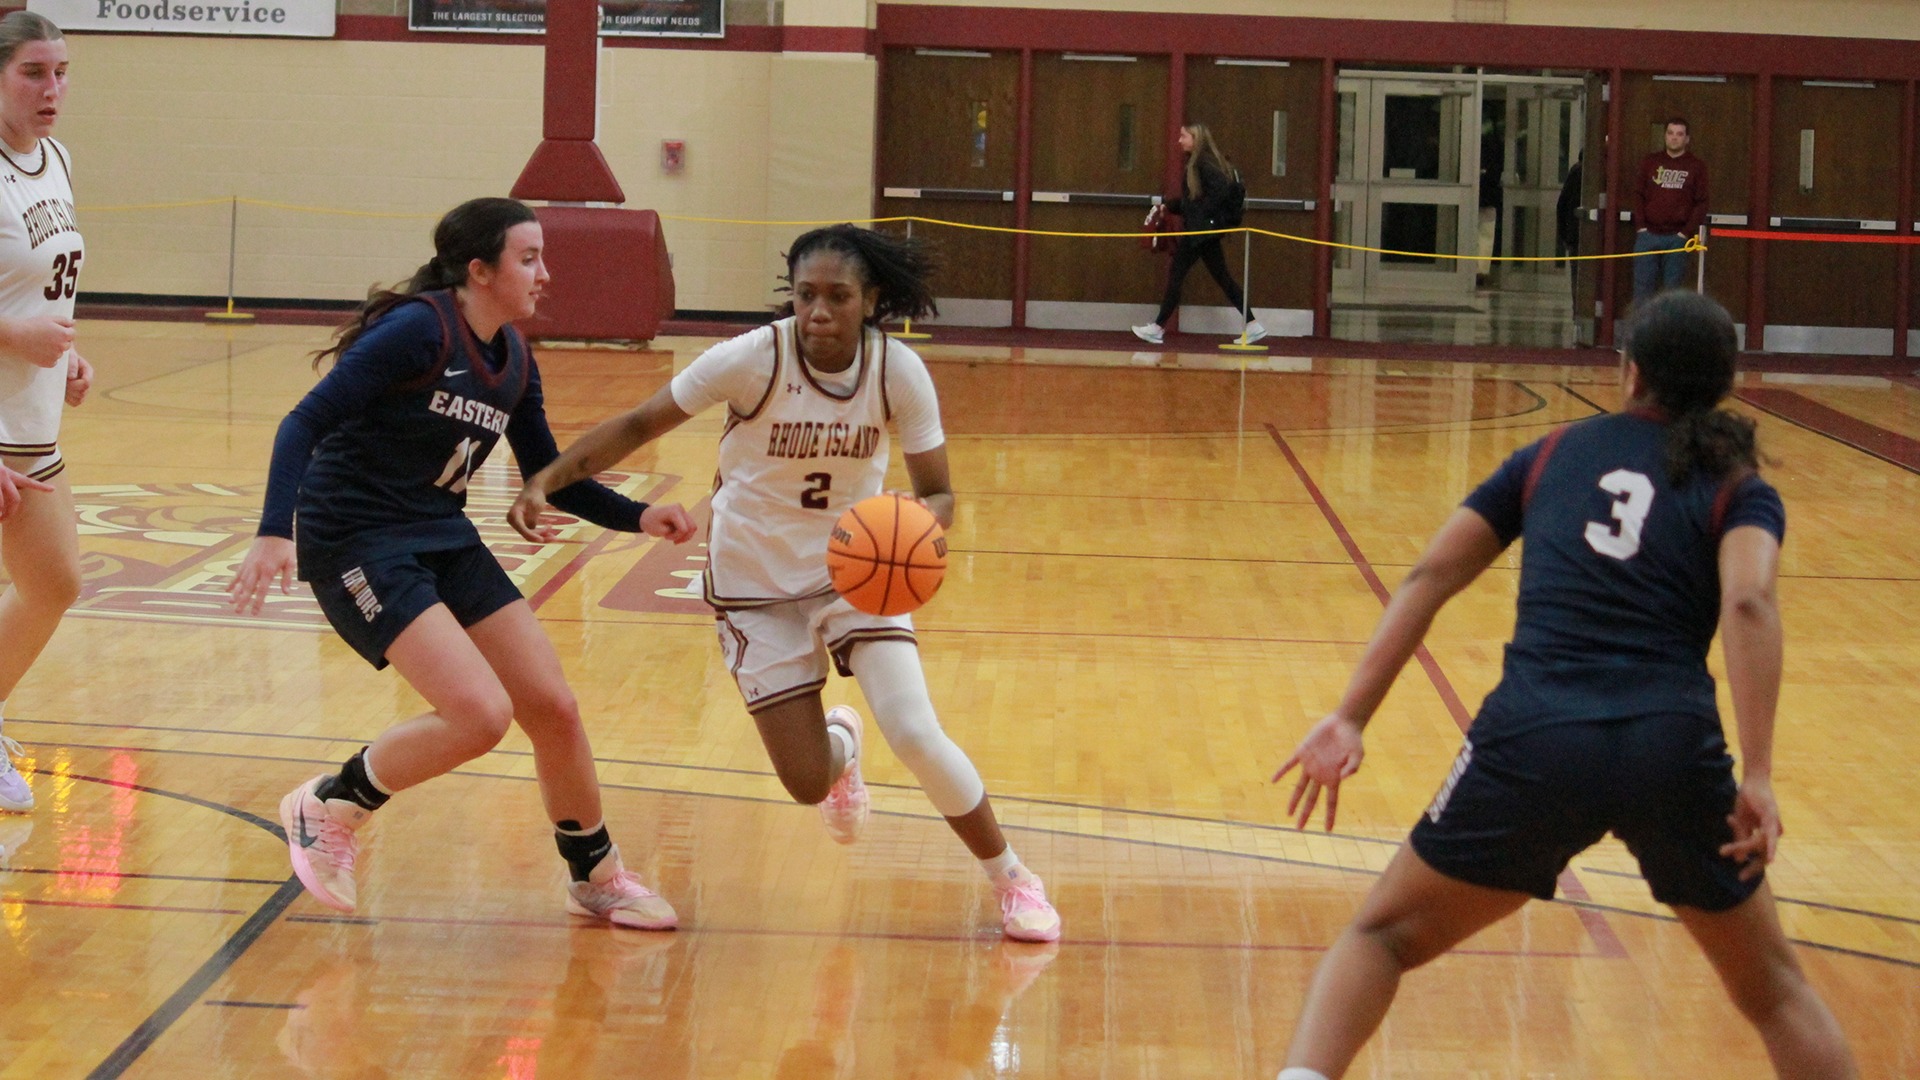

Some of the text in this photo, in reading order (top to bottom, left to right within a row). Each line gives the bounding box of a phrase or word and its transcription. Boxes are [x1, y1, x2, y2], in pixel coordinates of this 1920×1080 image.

[97, 0, 286, 23] Foodservice
[432, 12, 544, 22] THE LARGEST SELECTION
[615, 15, 667, 25] EQUIPMENT
[670, 17, 700, 25] NEEDS
[43, 249, 82, 302] 35
[767, 421, 880, 460] RHODE ISLAND
[800, 472, 832, 510] 2
[1584, 468, 1655, 561] 3
